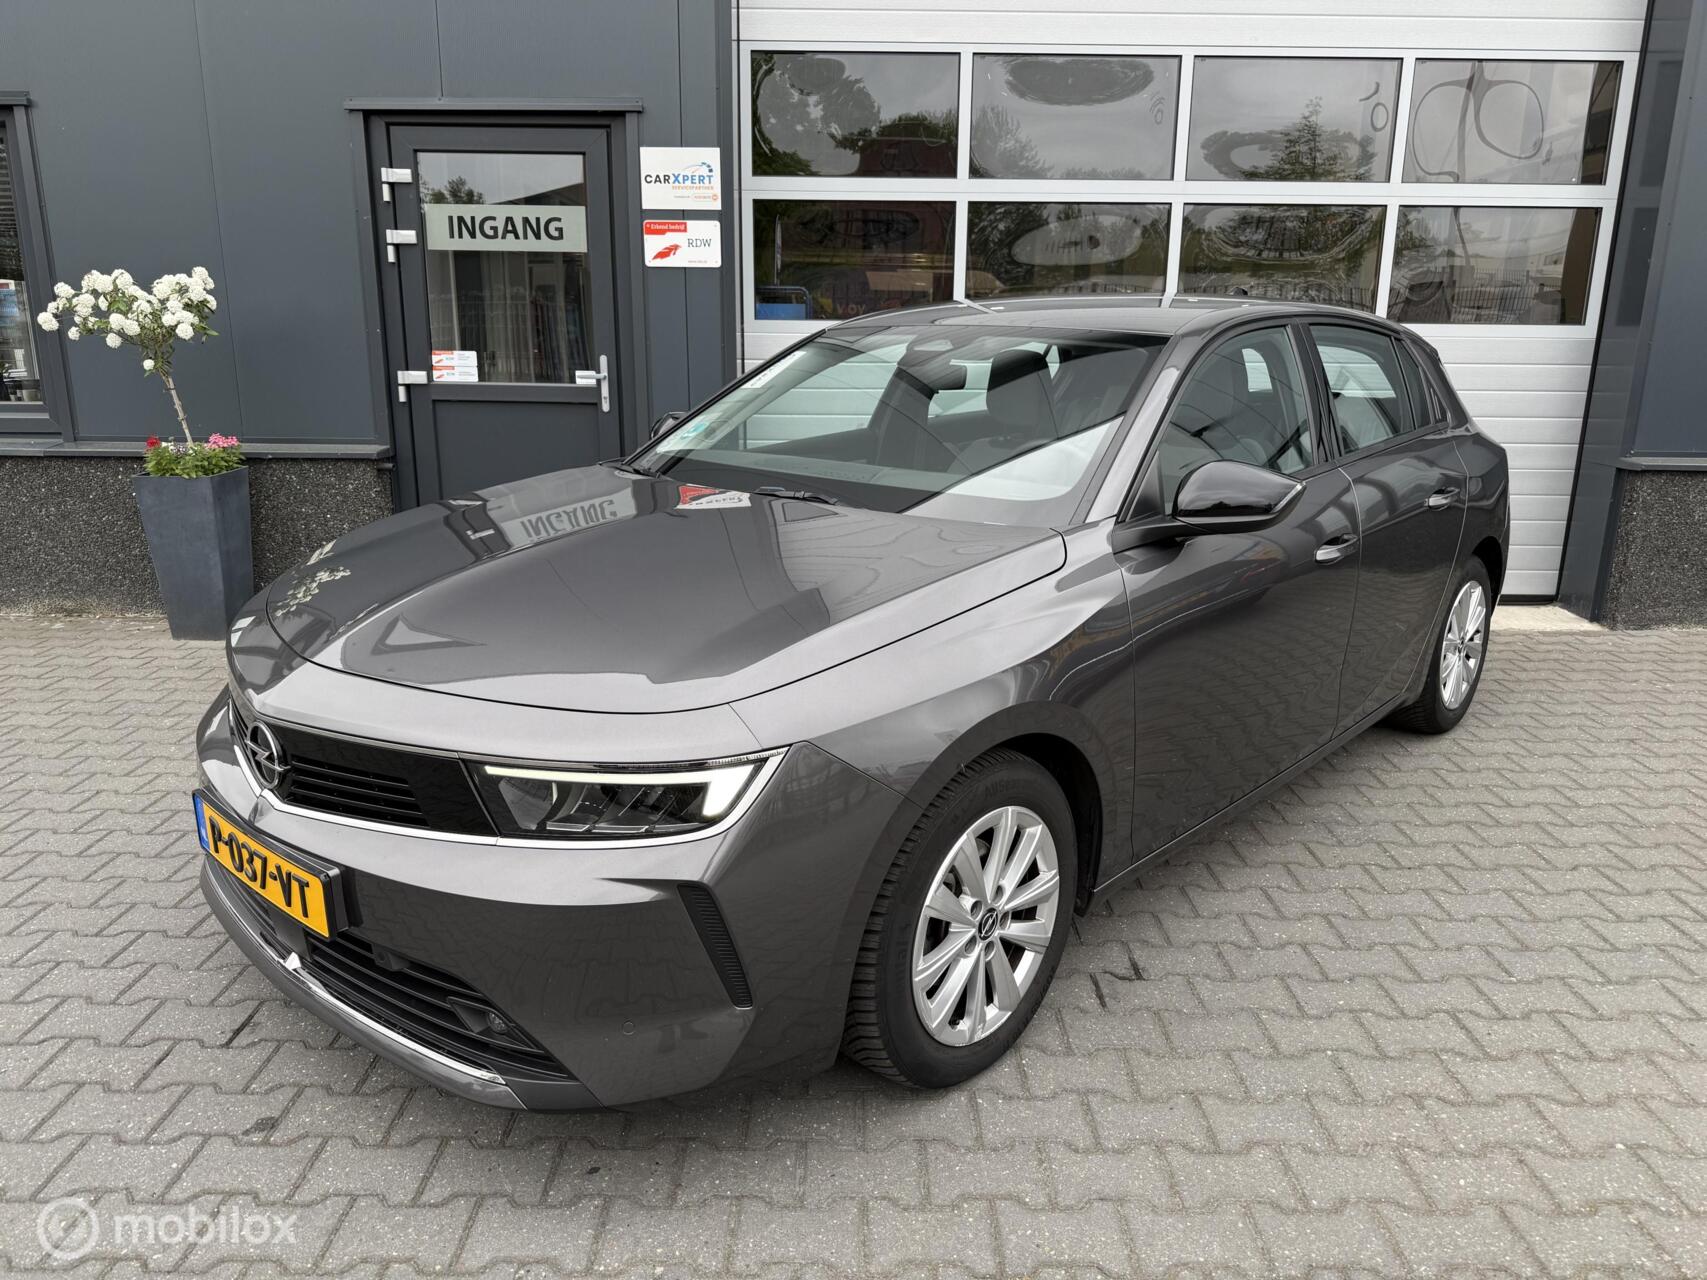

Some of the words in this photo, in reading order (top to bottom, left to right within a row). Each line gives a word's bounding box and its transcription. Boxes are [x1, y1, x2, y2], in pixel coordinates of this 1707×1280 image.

[644, 173, 714, 185] CARXPERT
[447, 215, 564, 241] INGANG
[687, 238, 712, 248] RDW
[208, 815, 310, 919] P-037-VT
